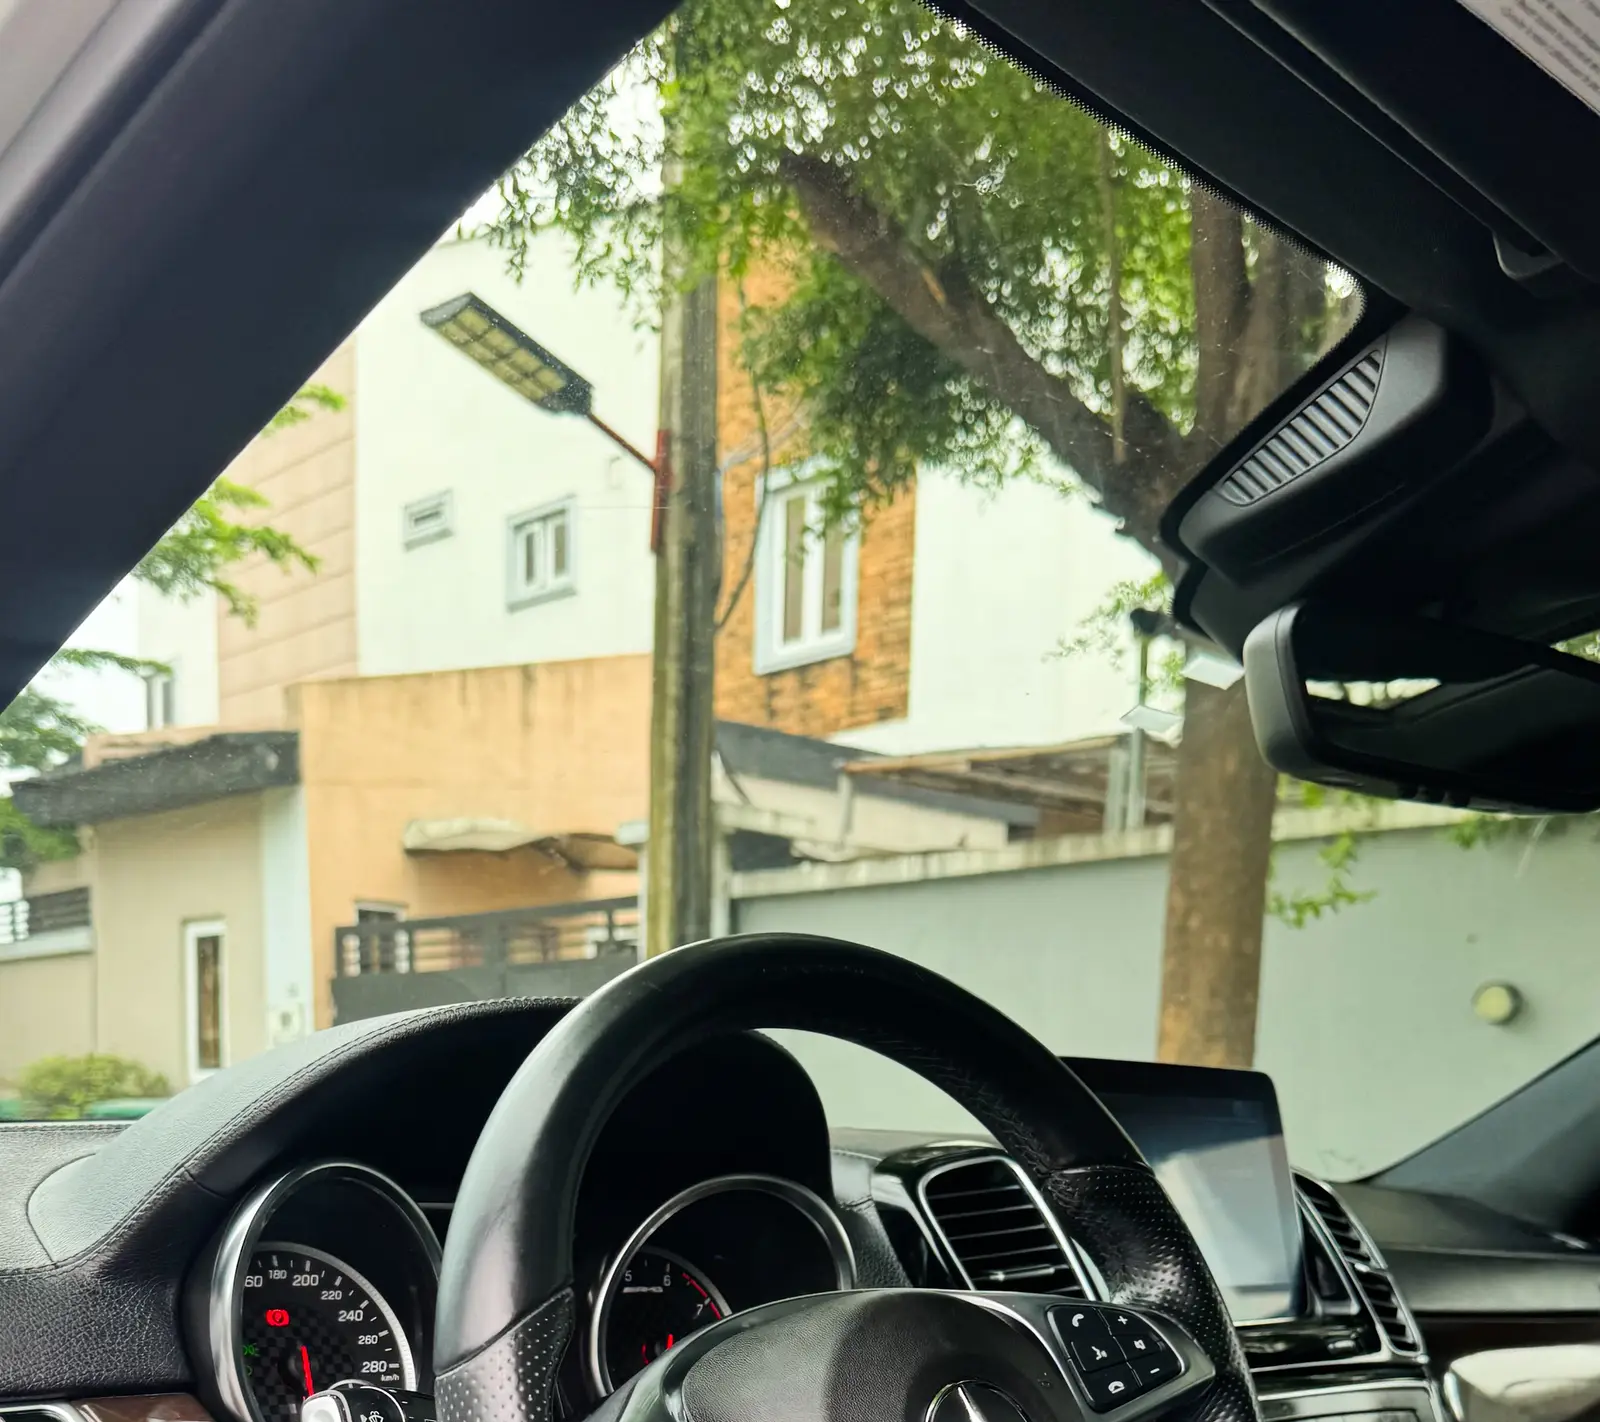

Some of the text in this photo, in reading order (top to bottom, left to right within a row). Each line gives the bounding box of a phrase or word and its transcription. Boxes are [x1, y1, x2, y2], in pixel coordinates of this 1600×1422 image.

[268, 1270, 287, 1280] 180
[292, 1274, 319, 1287] 200
[624, 1270, 633, 1282] 5
[663, 1275, 671, 1287] 6
[244, 1276, 263, 1288] 60
[321, 1290, 342, 1300] 220
[338, 1310, 363, 1322] 240
[696, 1304, 703, 1317] 7
[358, 1335, 378, 1345] 260
[361, 1361, 387, 1373] 280
[381, 1374, 400, 1382] km/h
